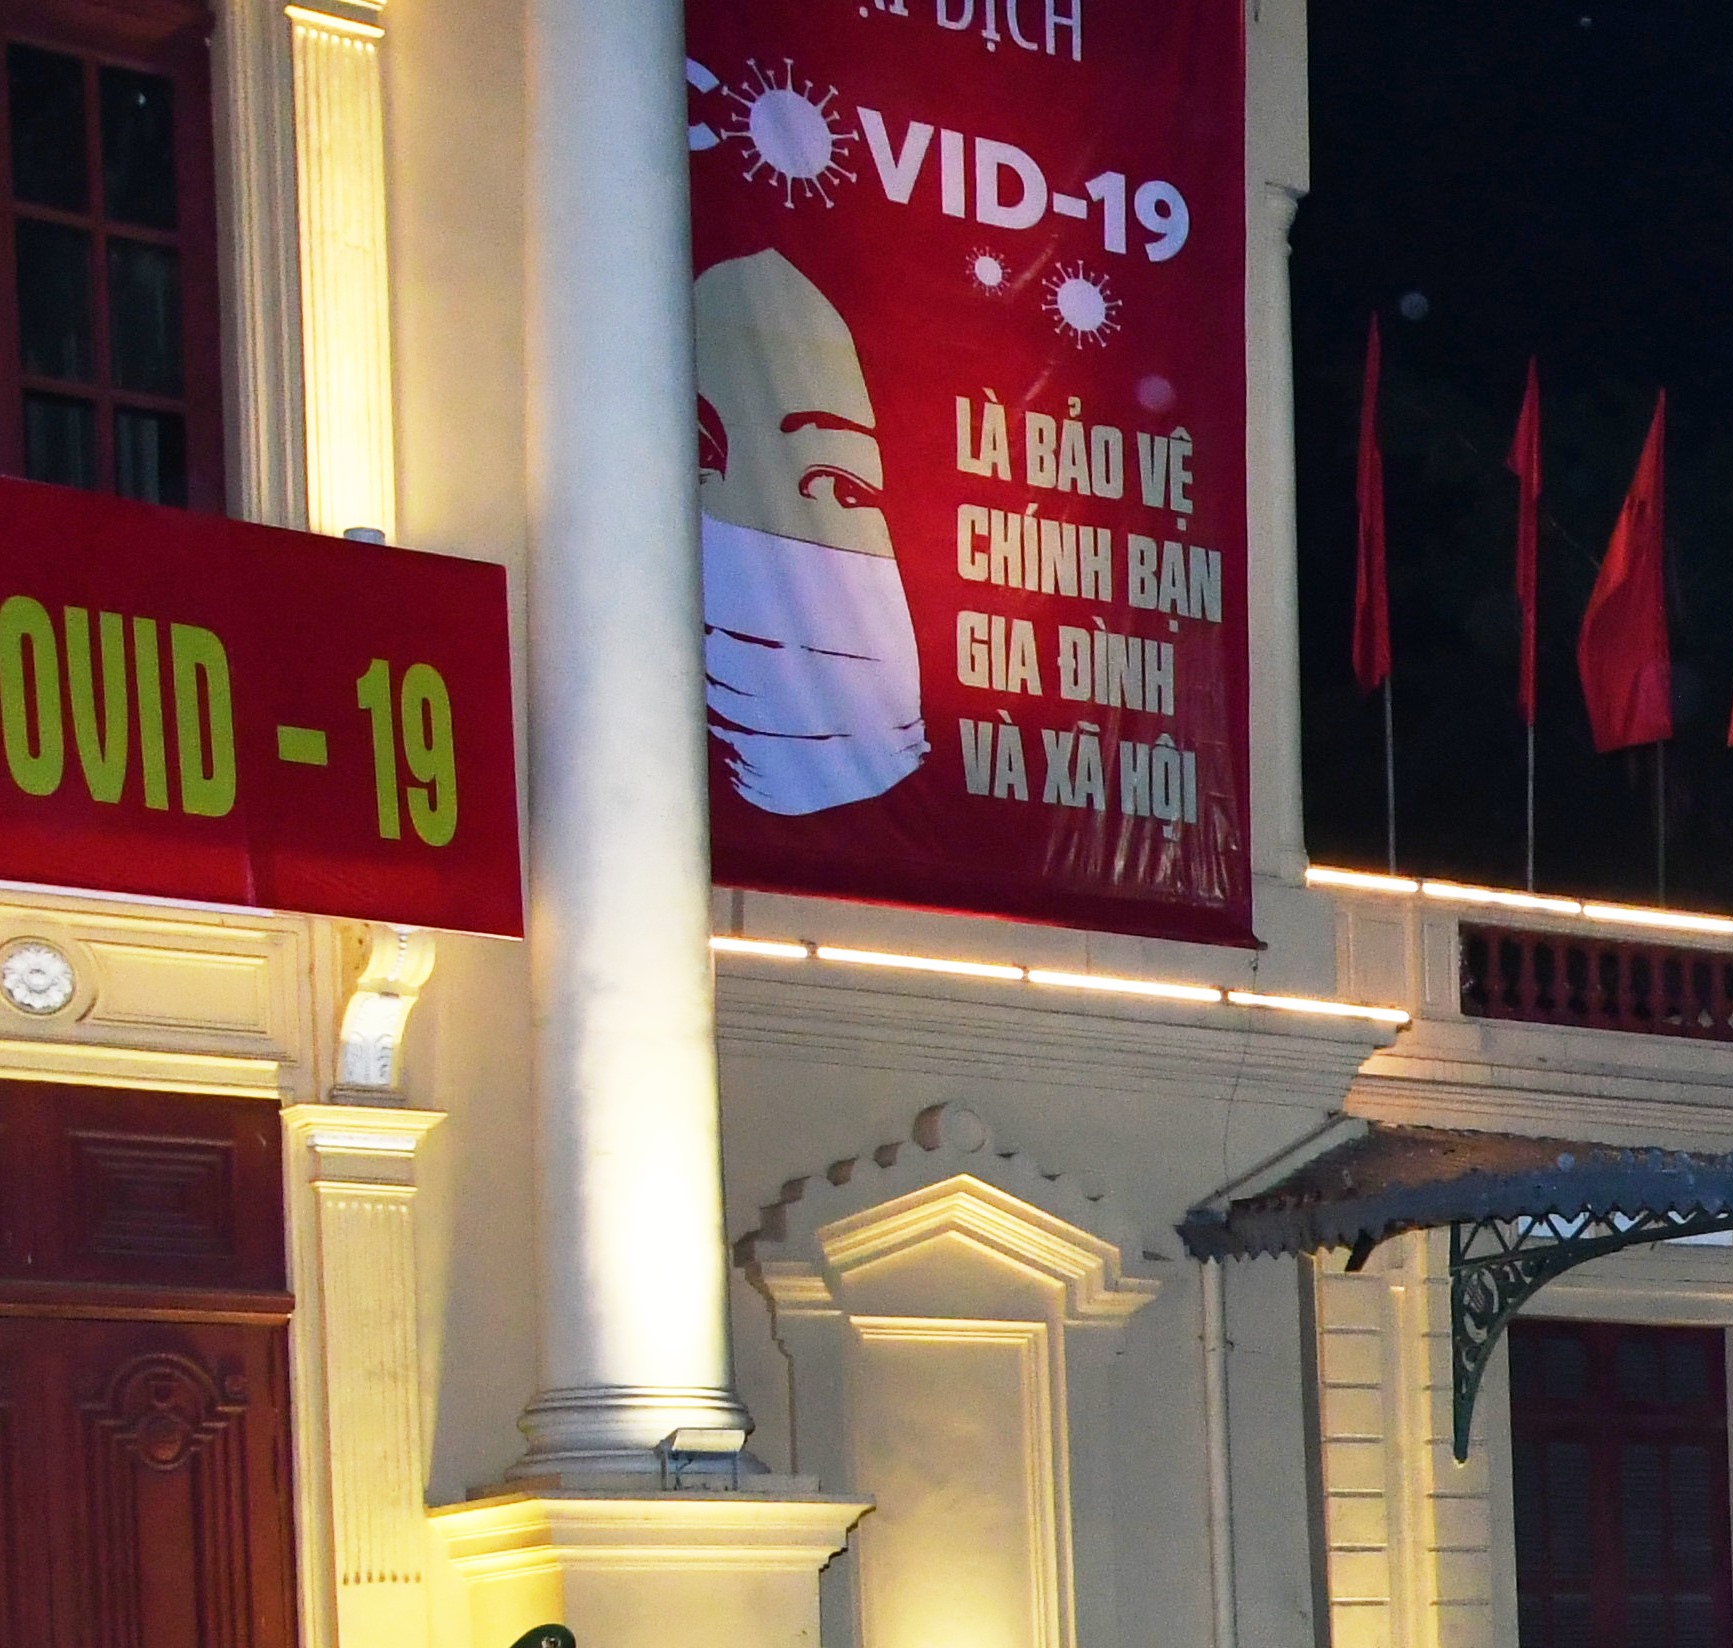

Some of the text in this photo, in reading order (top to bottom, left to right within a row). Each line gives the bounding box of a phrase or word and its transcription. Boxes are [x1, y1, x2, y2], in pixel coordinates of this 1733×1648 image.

[955, 387, 1194, 532] LÀ BẢO VỆ
[957, 502, 1223, 634] CHÍNH BẠN
[956, 609, 1175, 717] GIA ĐÌNH
[356, 657, 458, 848] 19
[958, 708, 1198, 843] VÀ XÃ HỘI
